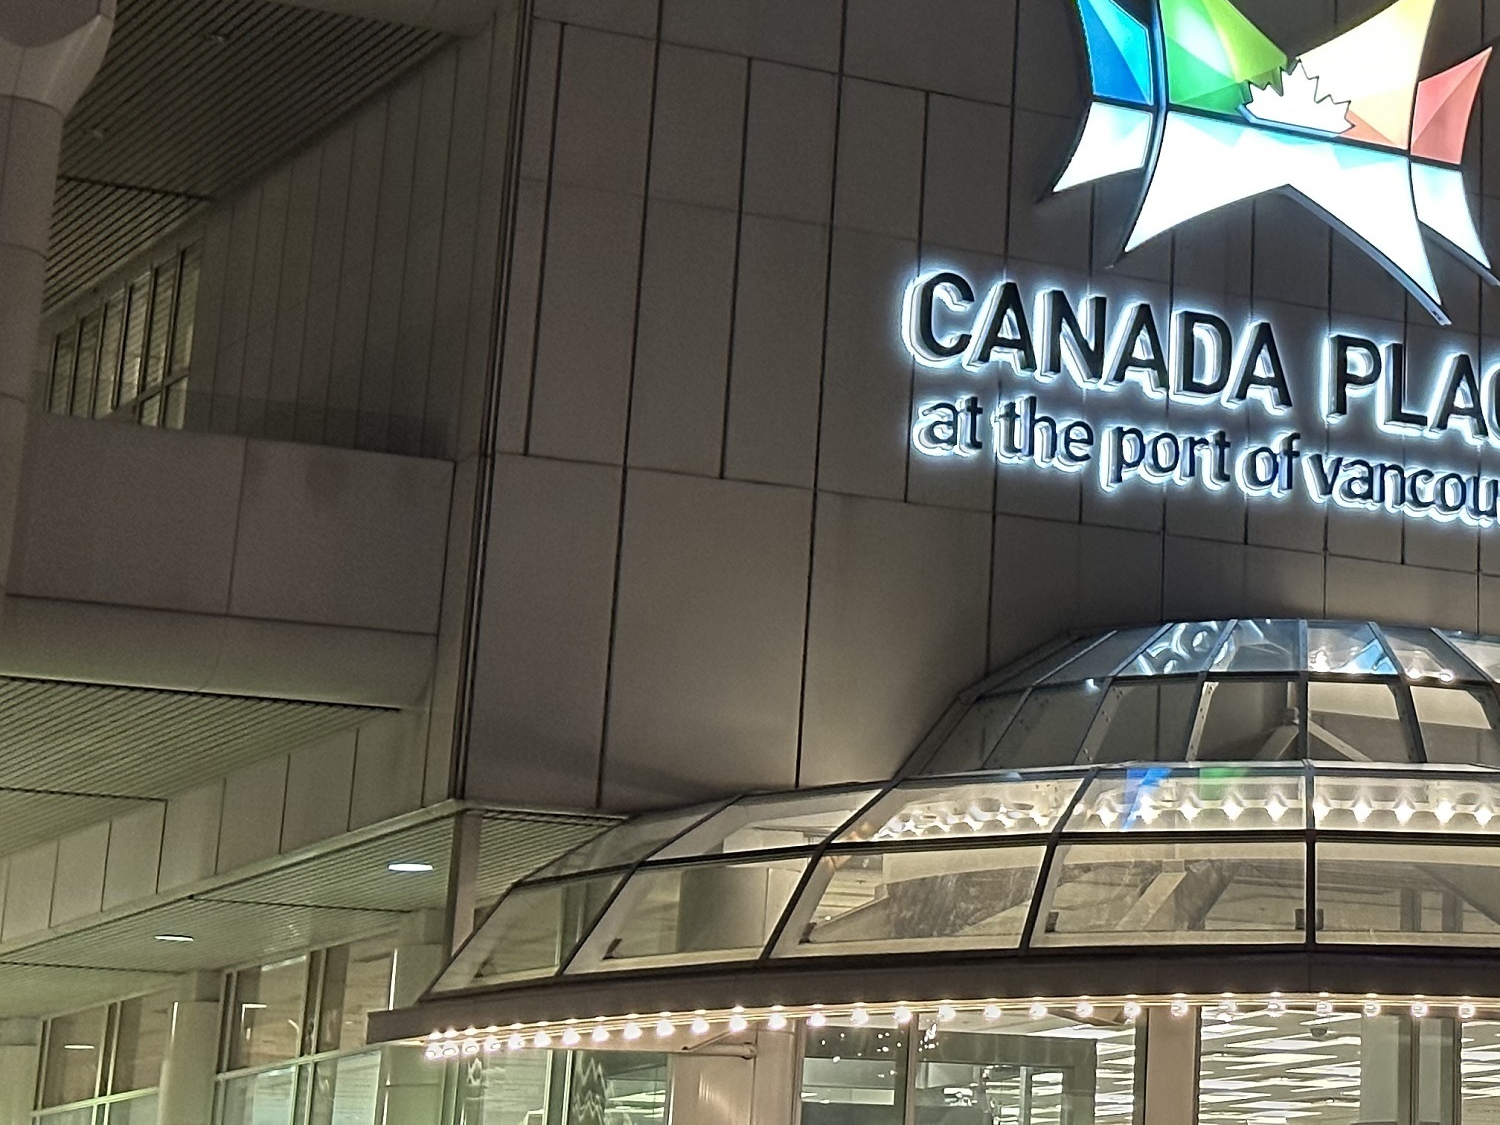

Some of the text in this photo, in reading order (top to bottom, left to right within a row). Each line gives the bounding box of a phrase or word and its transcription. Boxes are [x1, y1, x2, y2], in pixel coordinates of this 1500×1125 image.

[906, 271, 1294, 415] CANADA
[917, 395, 984, 453] at
[995, 395, 1095, 465] the
[1104, 425, 1232, 490] port
[1242, 431, 1301, 495] of
